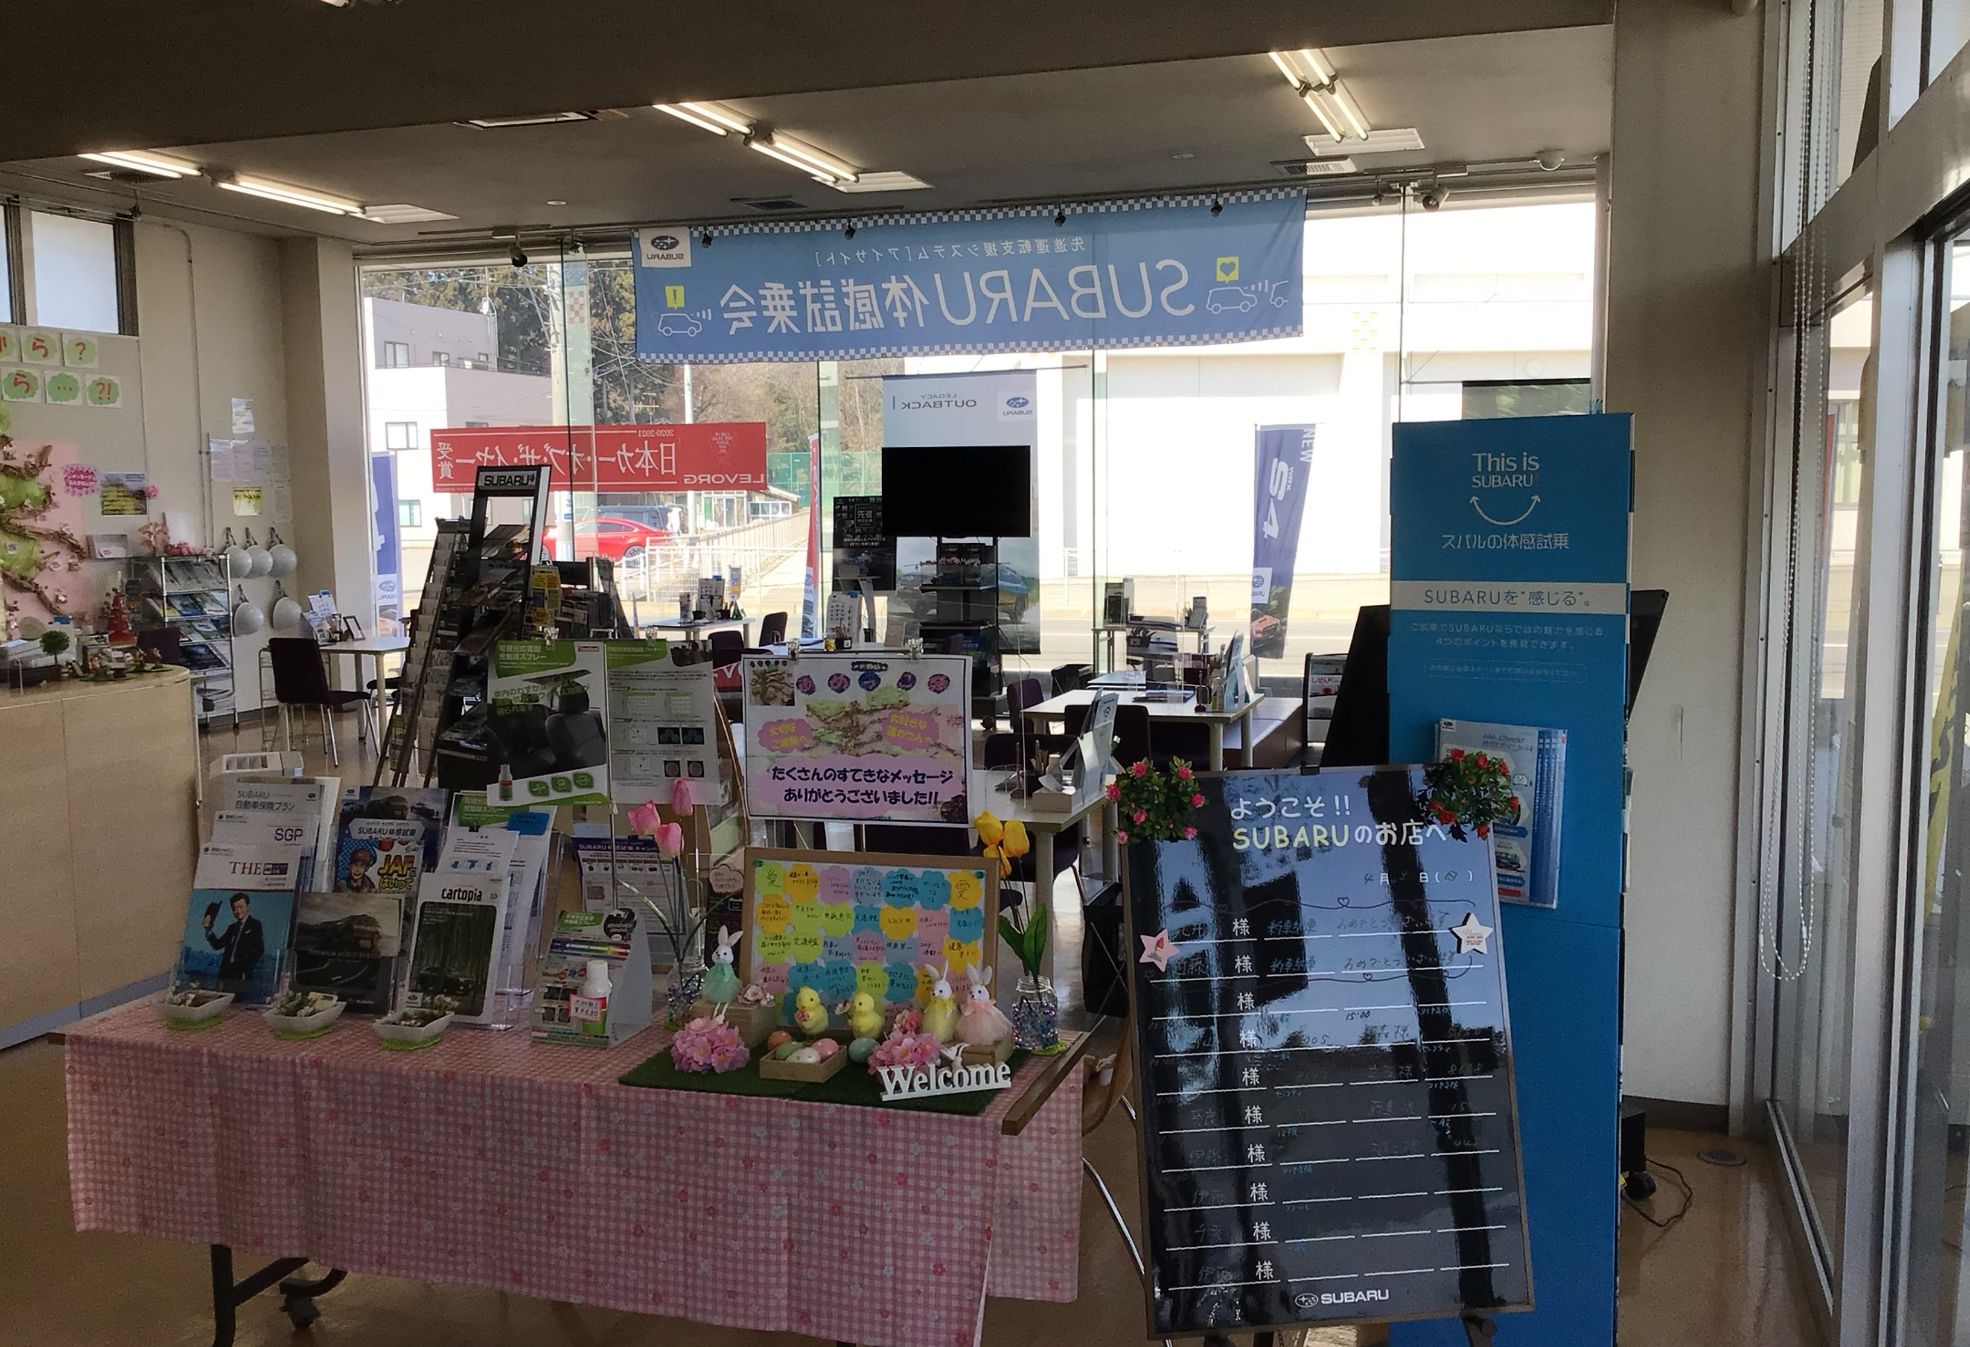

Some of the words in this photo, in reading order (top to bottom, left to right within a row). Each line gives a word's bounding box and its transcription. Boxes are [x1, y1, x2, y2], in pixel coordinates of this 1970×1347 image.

[1472, 453, 1518, 472] This
[1522, 452, 1540, 472] is
[484, 474, 530, 488] SUBARU
[1441, 532, 1570, 550] スバルの体感試乗
[771, 765, 954, 785] たくさんのすてきなメッセージ
[783, 787, 939, 806] ありがとうございました!!
[273, 827, 304, 843] SGP
[229, 861, 263, 875] THE
[441, 887, 483, 903] cartopia
[1232, 918, 1251, 936] 様
[1234, 954, 1253, 974] 様
[1236, 992, 1255, 1011] 様
[1239, 1029, 1258, 1048] 様
[879, 1061, 1011, 1096] Welcome
[1242, 1067, 1261, 1086] 様
[1244, 1104, 1263, 1125] 様
[1247, 1143, 1266, 1163] 様
[1250, 1182, 1269, 1202] 様
[1252, 1220, 1271, 1241] 様
[1255, 1260, 1274, 1280] 様
[1320, 1288, 1391, 1304] SUBARU
